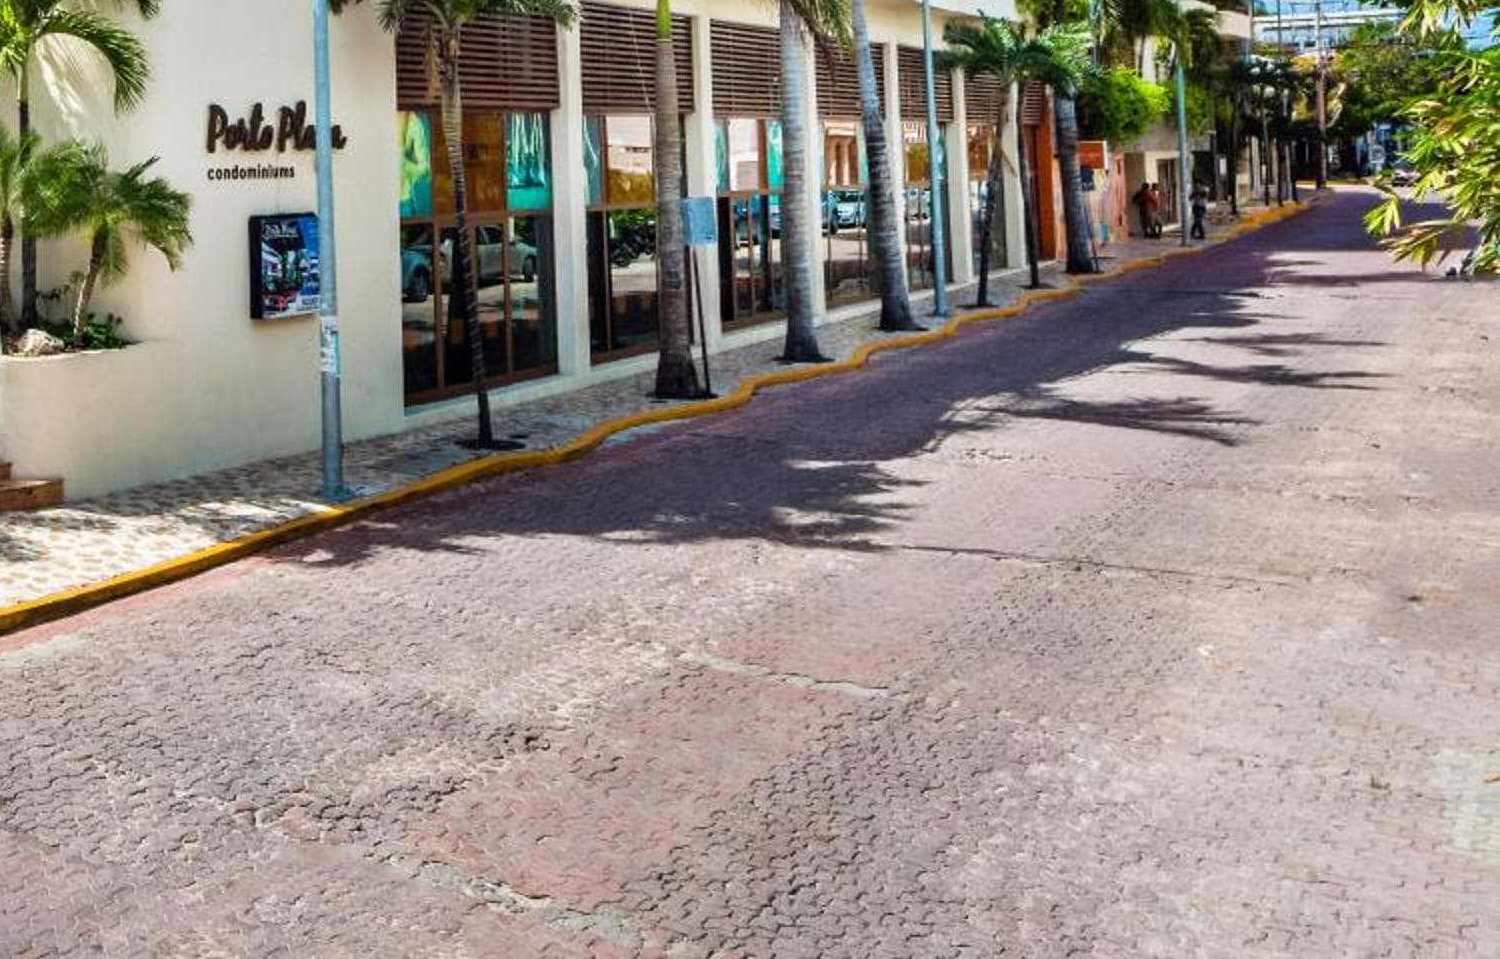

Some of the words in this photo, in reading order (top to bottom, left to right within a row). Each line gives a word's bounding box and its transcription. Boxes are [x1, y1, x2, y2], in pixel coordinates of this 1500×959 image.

[206, 102, 274, 153] Porto
[276, 99, 348, 153] Plaa
[207, 164, 295, 180] condominiums
